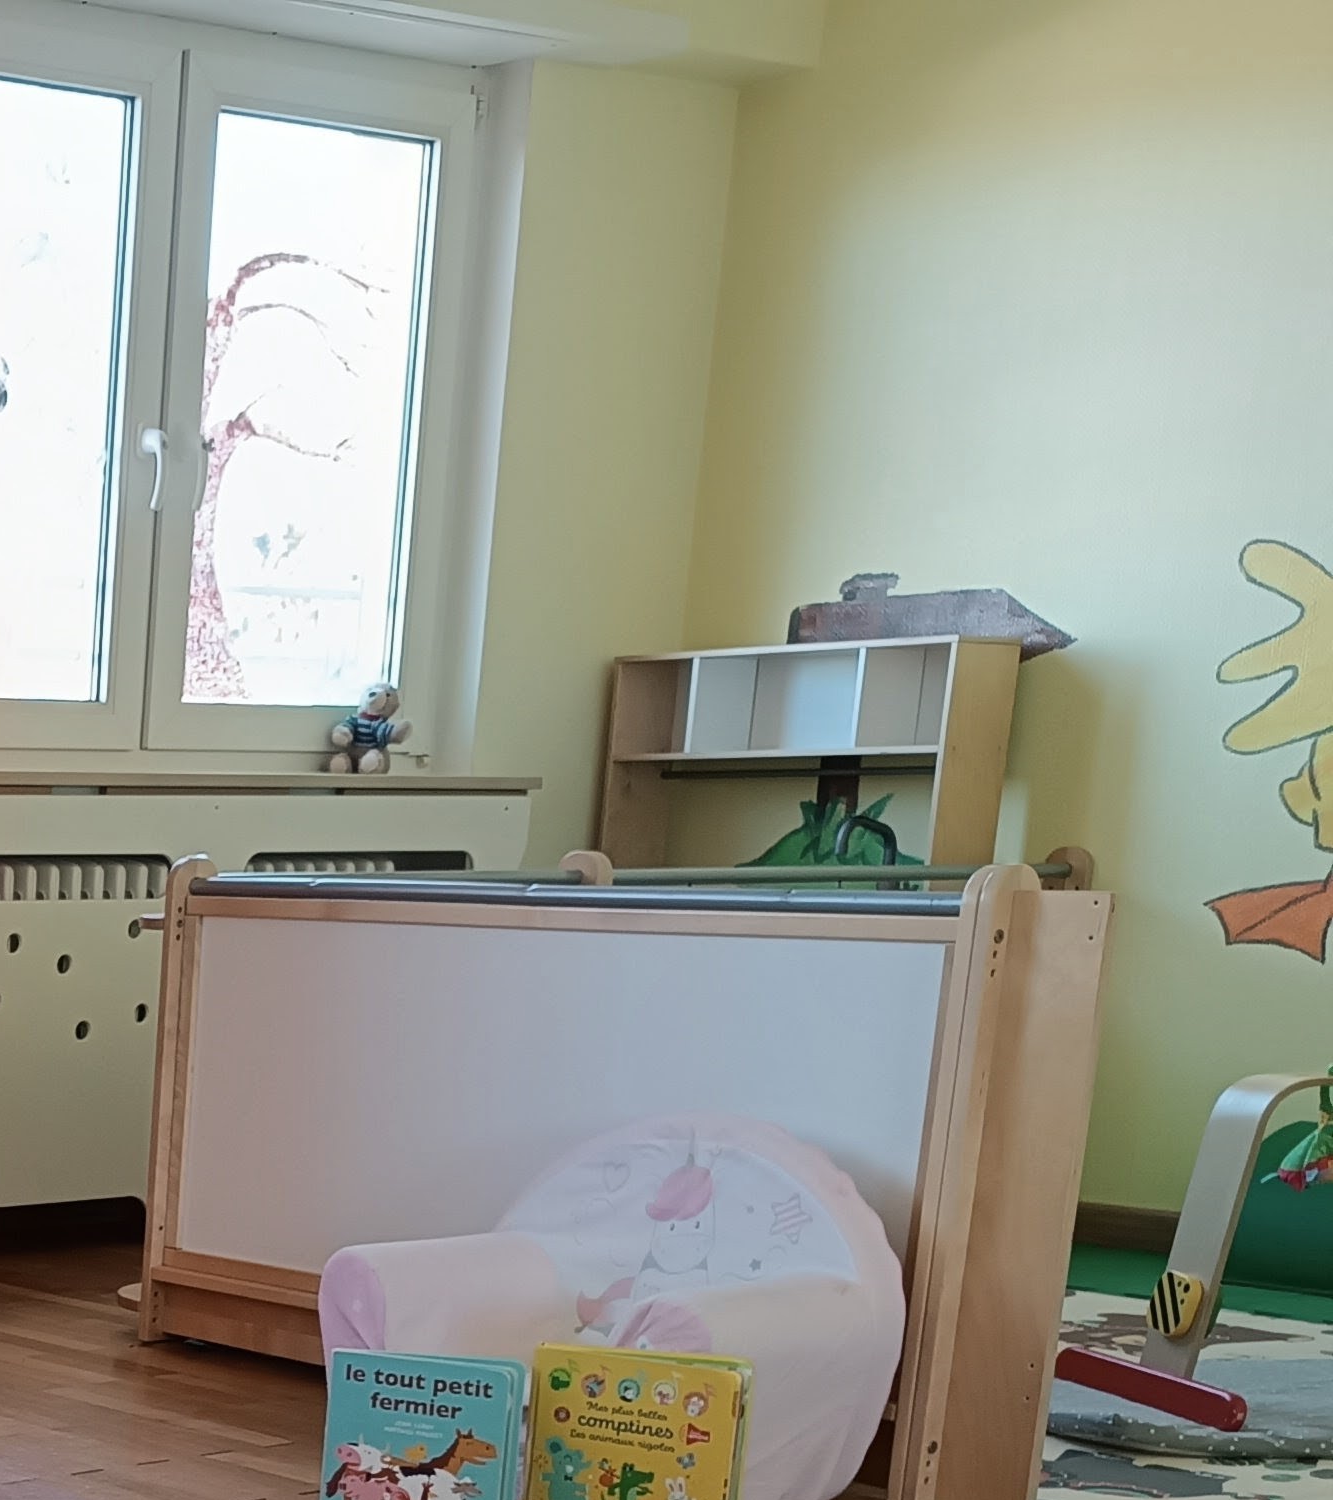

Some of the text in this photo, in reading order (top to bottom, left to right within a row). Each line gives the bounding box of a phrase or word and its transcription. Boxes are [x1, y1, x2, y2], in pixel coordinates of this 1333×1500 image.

[346, 1364, 493, 1398] le tout petit
[370, 1392, 462, 1419] fermier
[586, 1401, 668, 1421] Mes plus belles
[578, 1415, 673, 1439] comptines
[570, 1429, 675, 1453] Les animaux rigolos
